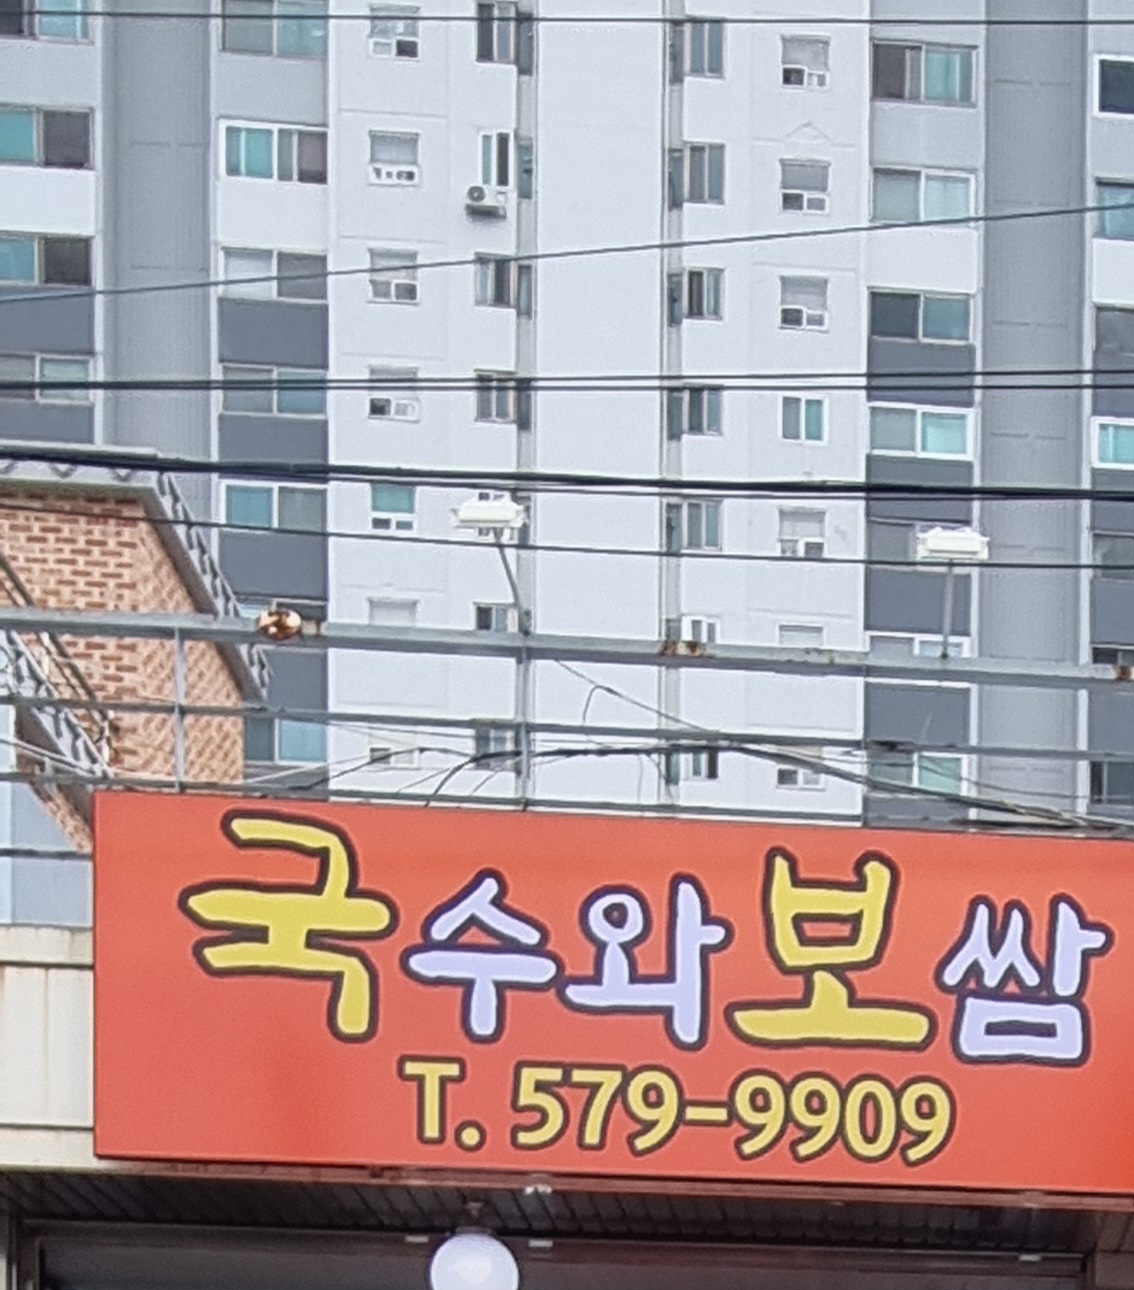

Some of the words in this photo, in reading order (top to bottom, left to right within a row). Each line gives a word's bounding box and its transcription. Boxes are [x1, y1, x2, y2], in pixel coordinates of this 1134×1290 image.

[181, 809, 1112, 1066] 국수와보쌈
[398, 1055, 486, 1151] T.
[511, 1060, 957, 1166] 579-9909
